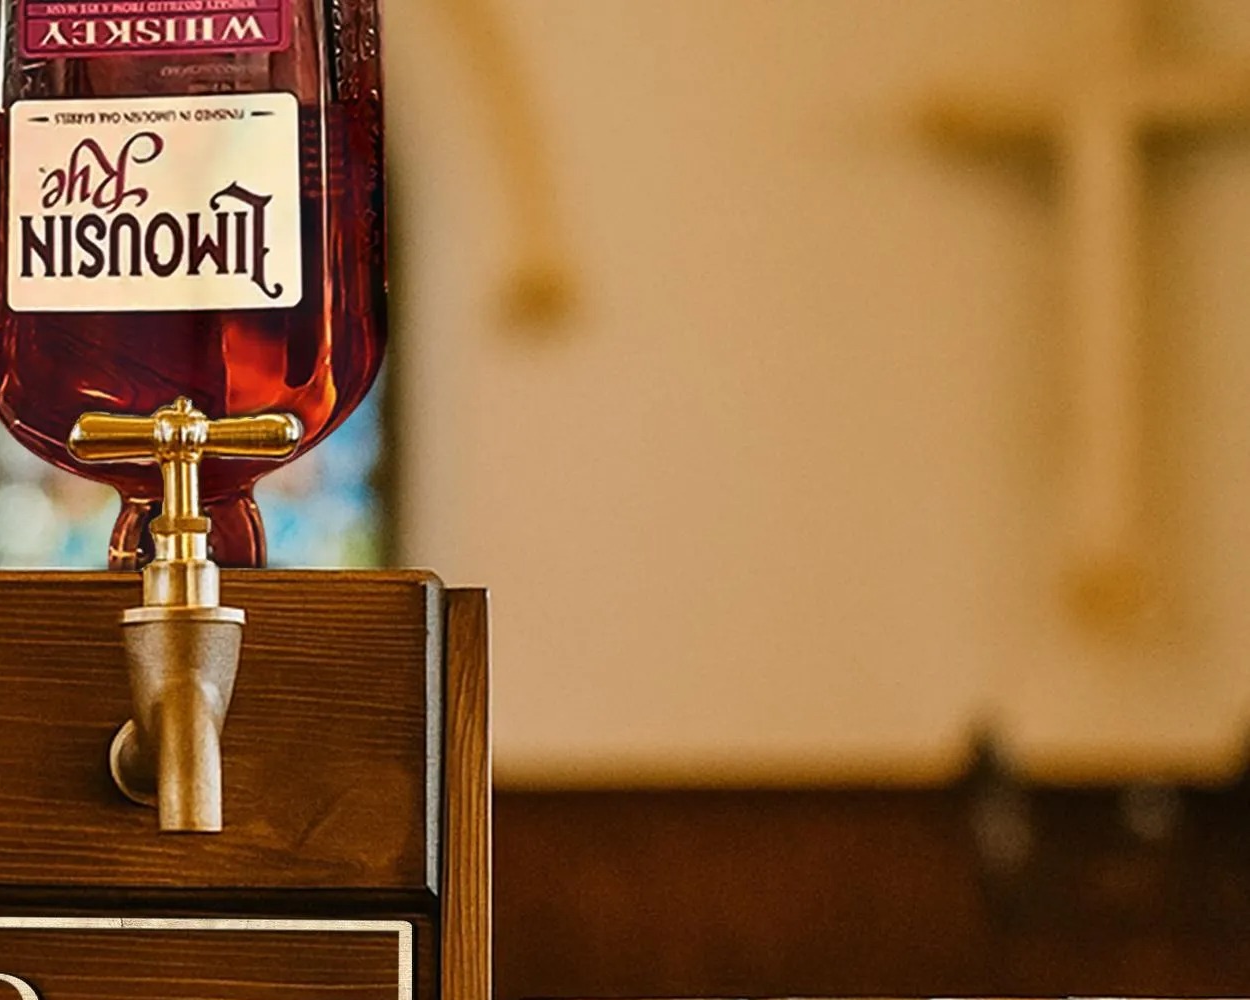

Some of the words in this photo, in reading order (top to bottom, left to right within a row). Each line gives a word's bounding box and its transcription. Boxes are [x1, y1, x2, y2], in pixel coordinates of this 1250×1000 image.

[40, 15, 265, 46] WHISKEY
[39, 131, 164, 213] Rye
[20, 182, 283, 299] LIMOUSIN
